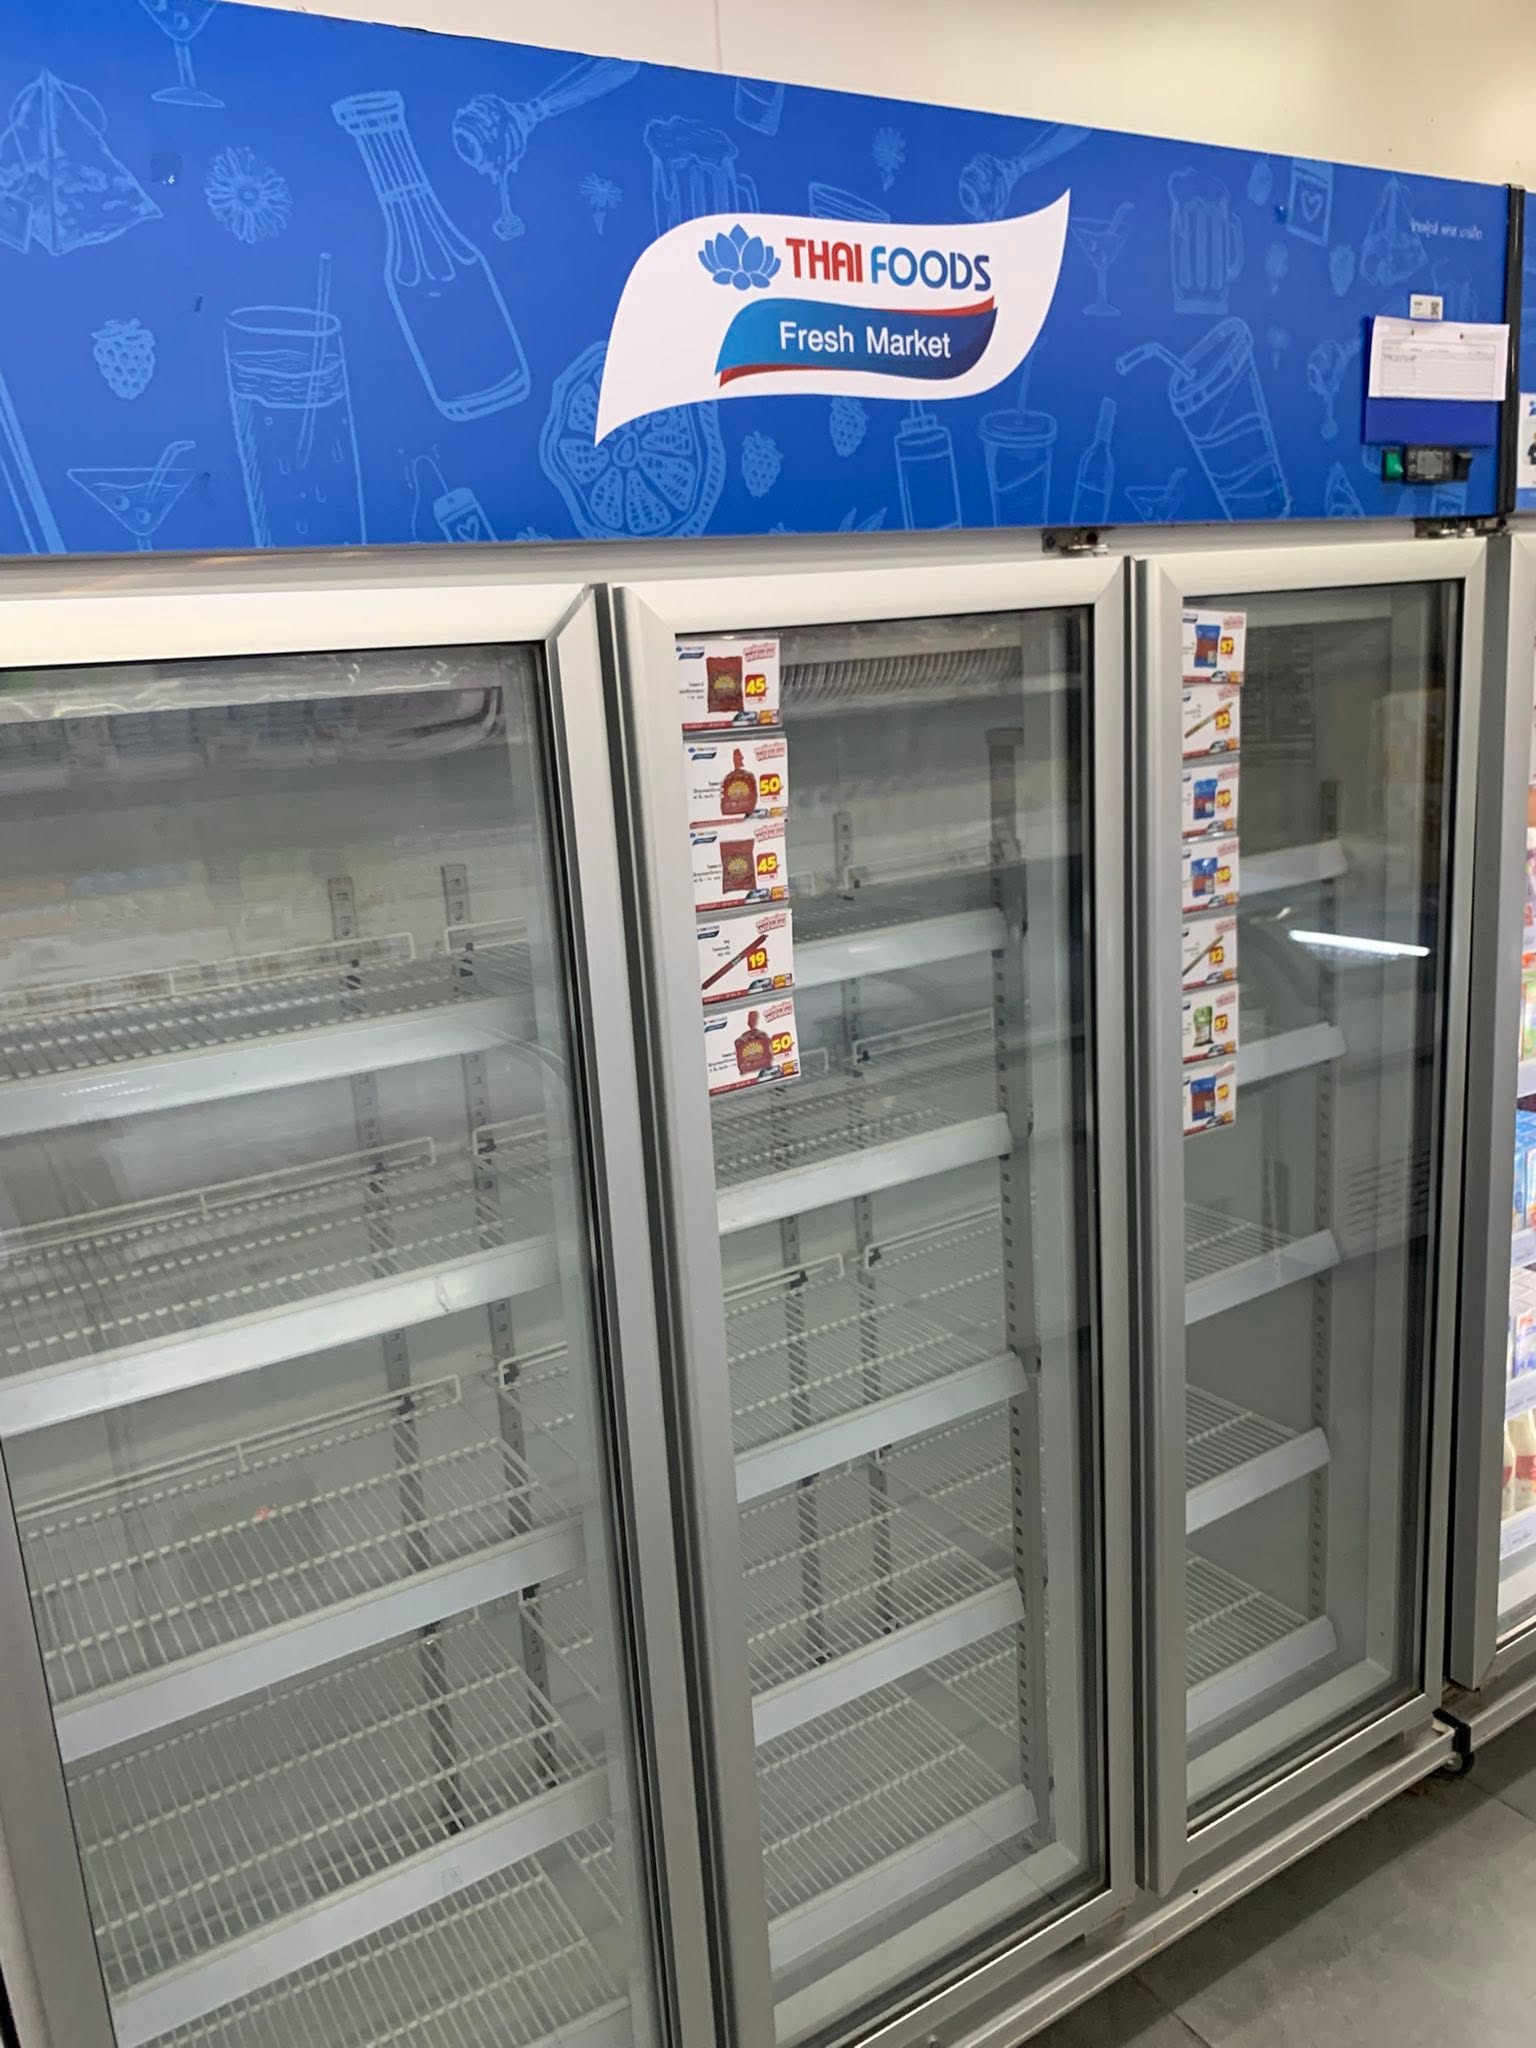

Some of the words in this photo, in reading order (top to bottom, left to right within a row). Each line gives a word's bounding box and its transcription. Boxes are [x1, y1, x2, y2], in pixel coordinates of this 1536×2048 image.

[785, 237, 863, 283] THAI
[870, 245, 991, 292] FOODS
[779, 321, 854, 354] Fresh
[866, 326, 951, 359] Market
[746, 676, 765, 695] 45
[759, 776, 780, 795] 50
[758, 855, 777, 873] 45
[748, 950, 766, 969] 19
[771, 1035, 792, 1054] 50
